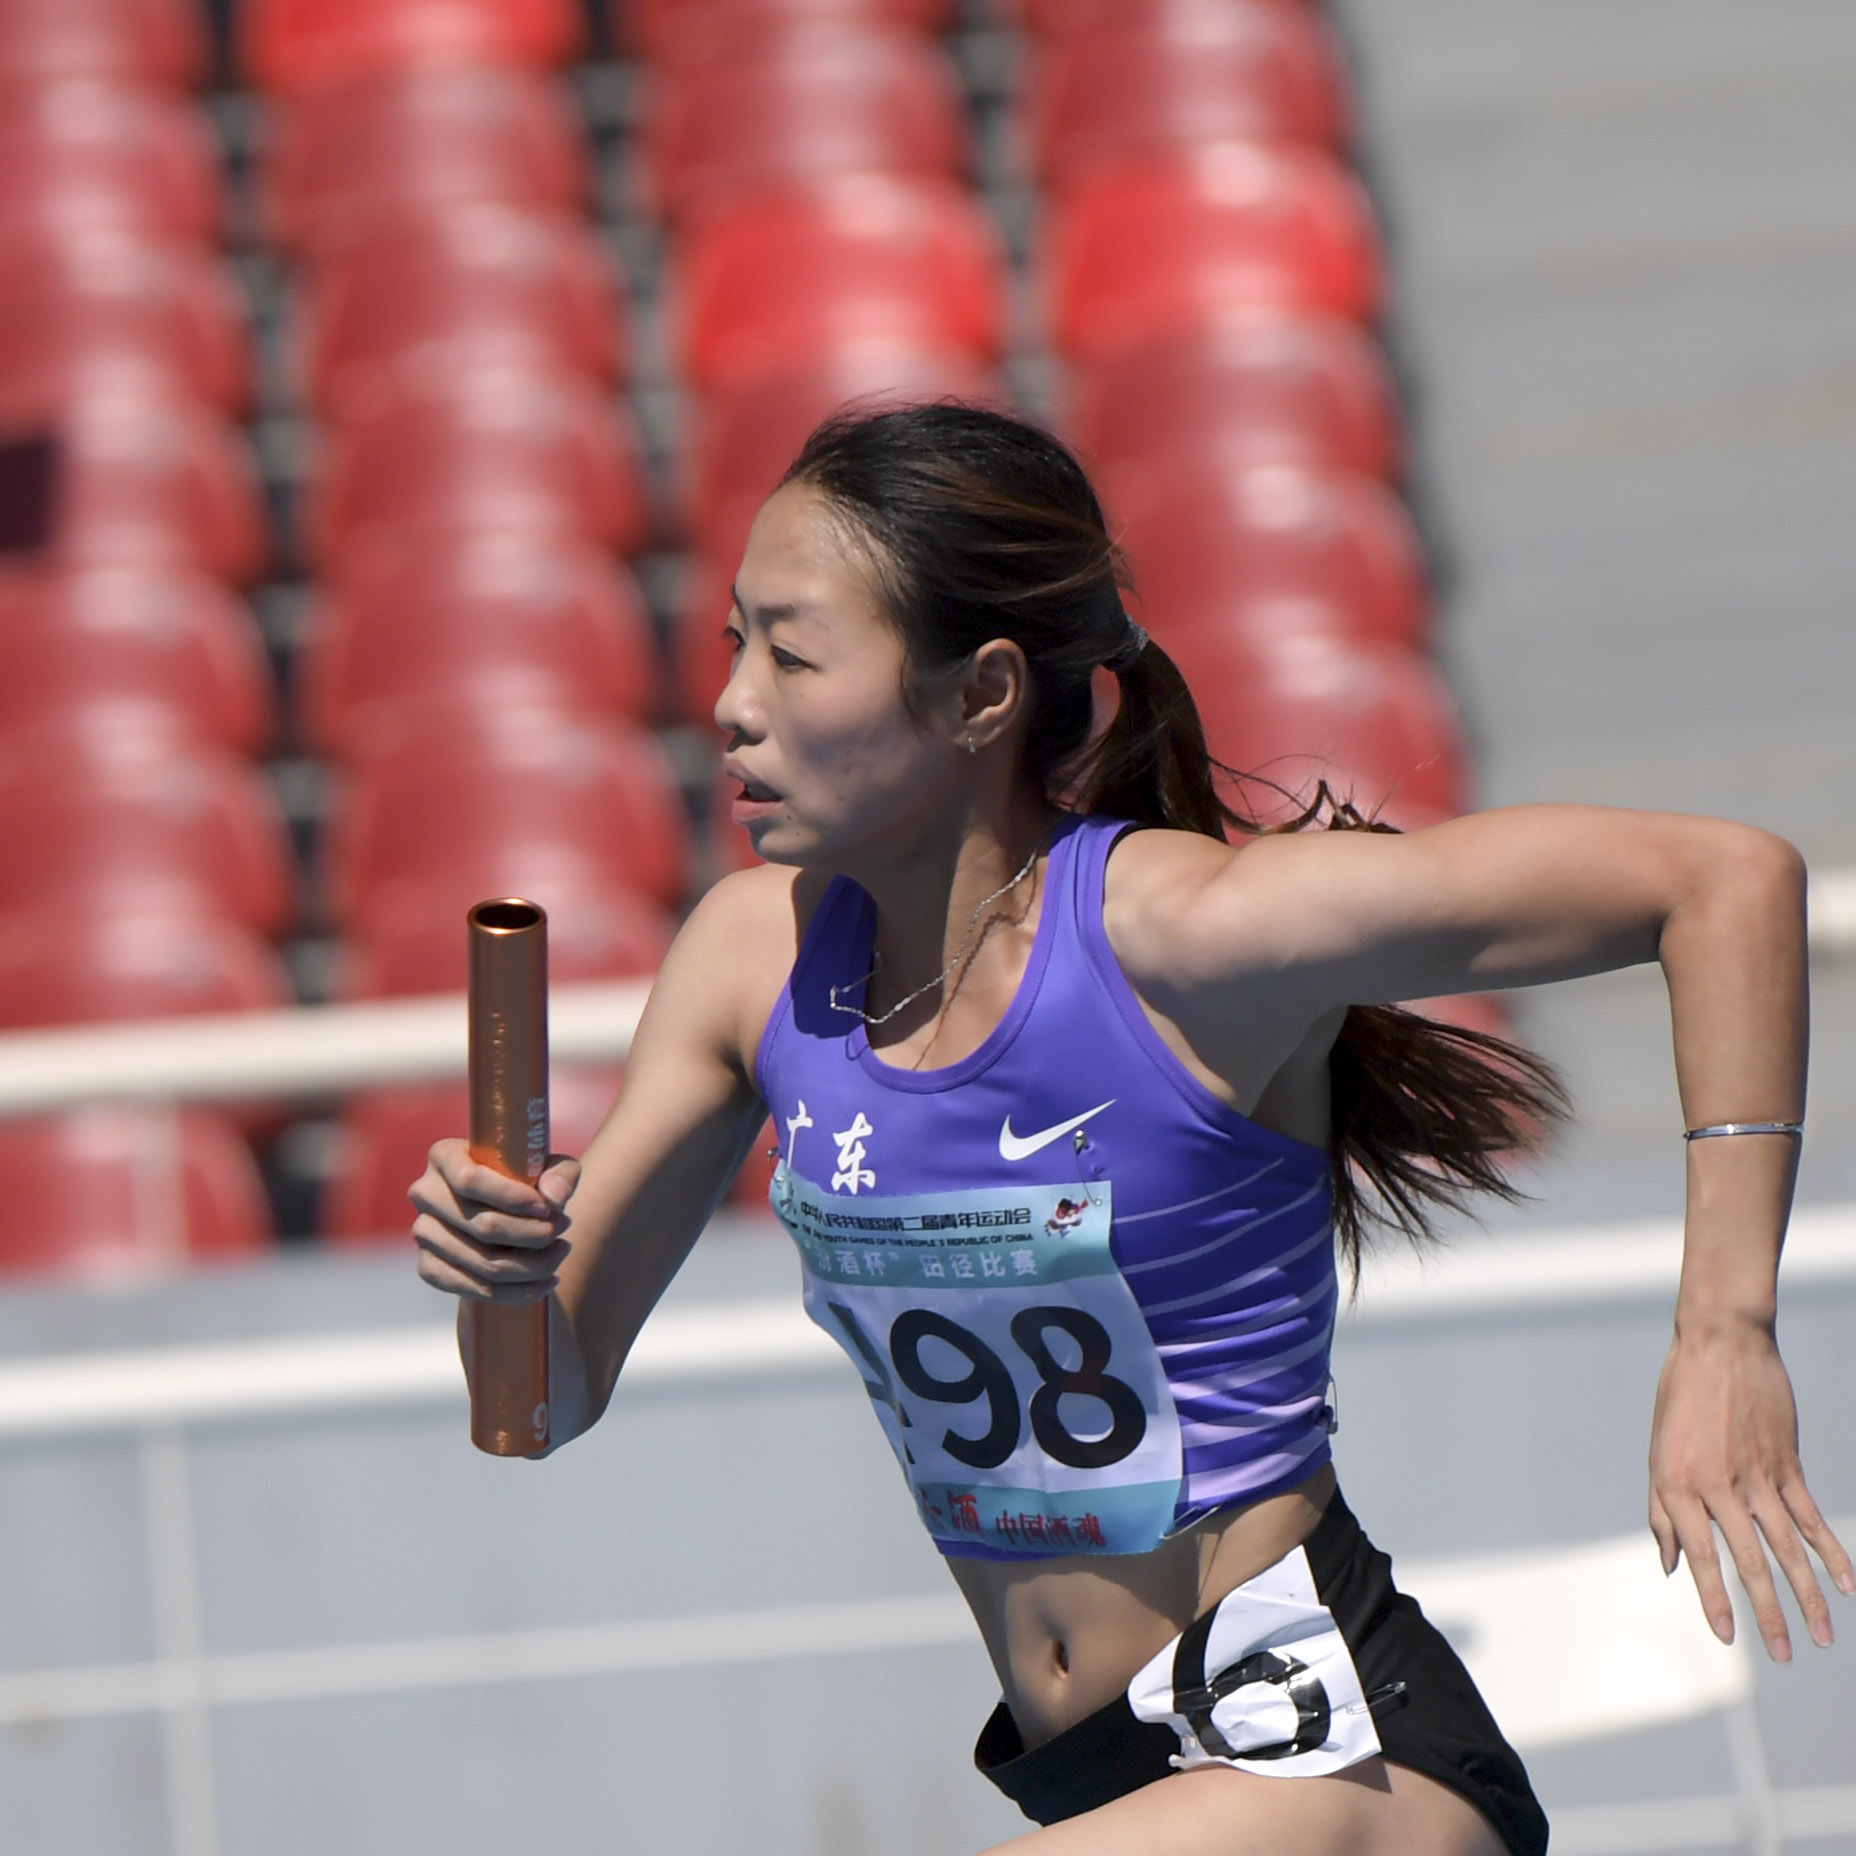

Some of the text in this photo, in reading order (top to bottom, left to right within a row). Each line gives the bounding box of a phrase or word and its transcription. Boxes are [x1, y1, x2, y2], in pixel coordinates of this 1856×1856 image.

[785, 1098, 876, 1196] 广东
[919, 1249, 1037, 1279] 田径比赛
[990, 1234, 1002, 1244] OF
[1173, 1600, 1331, 1760] 6
